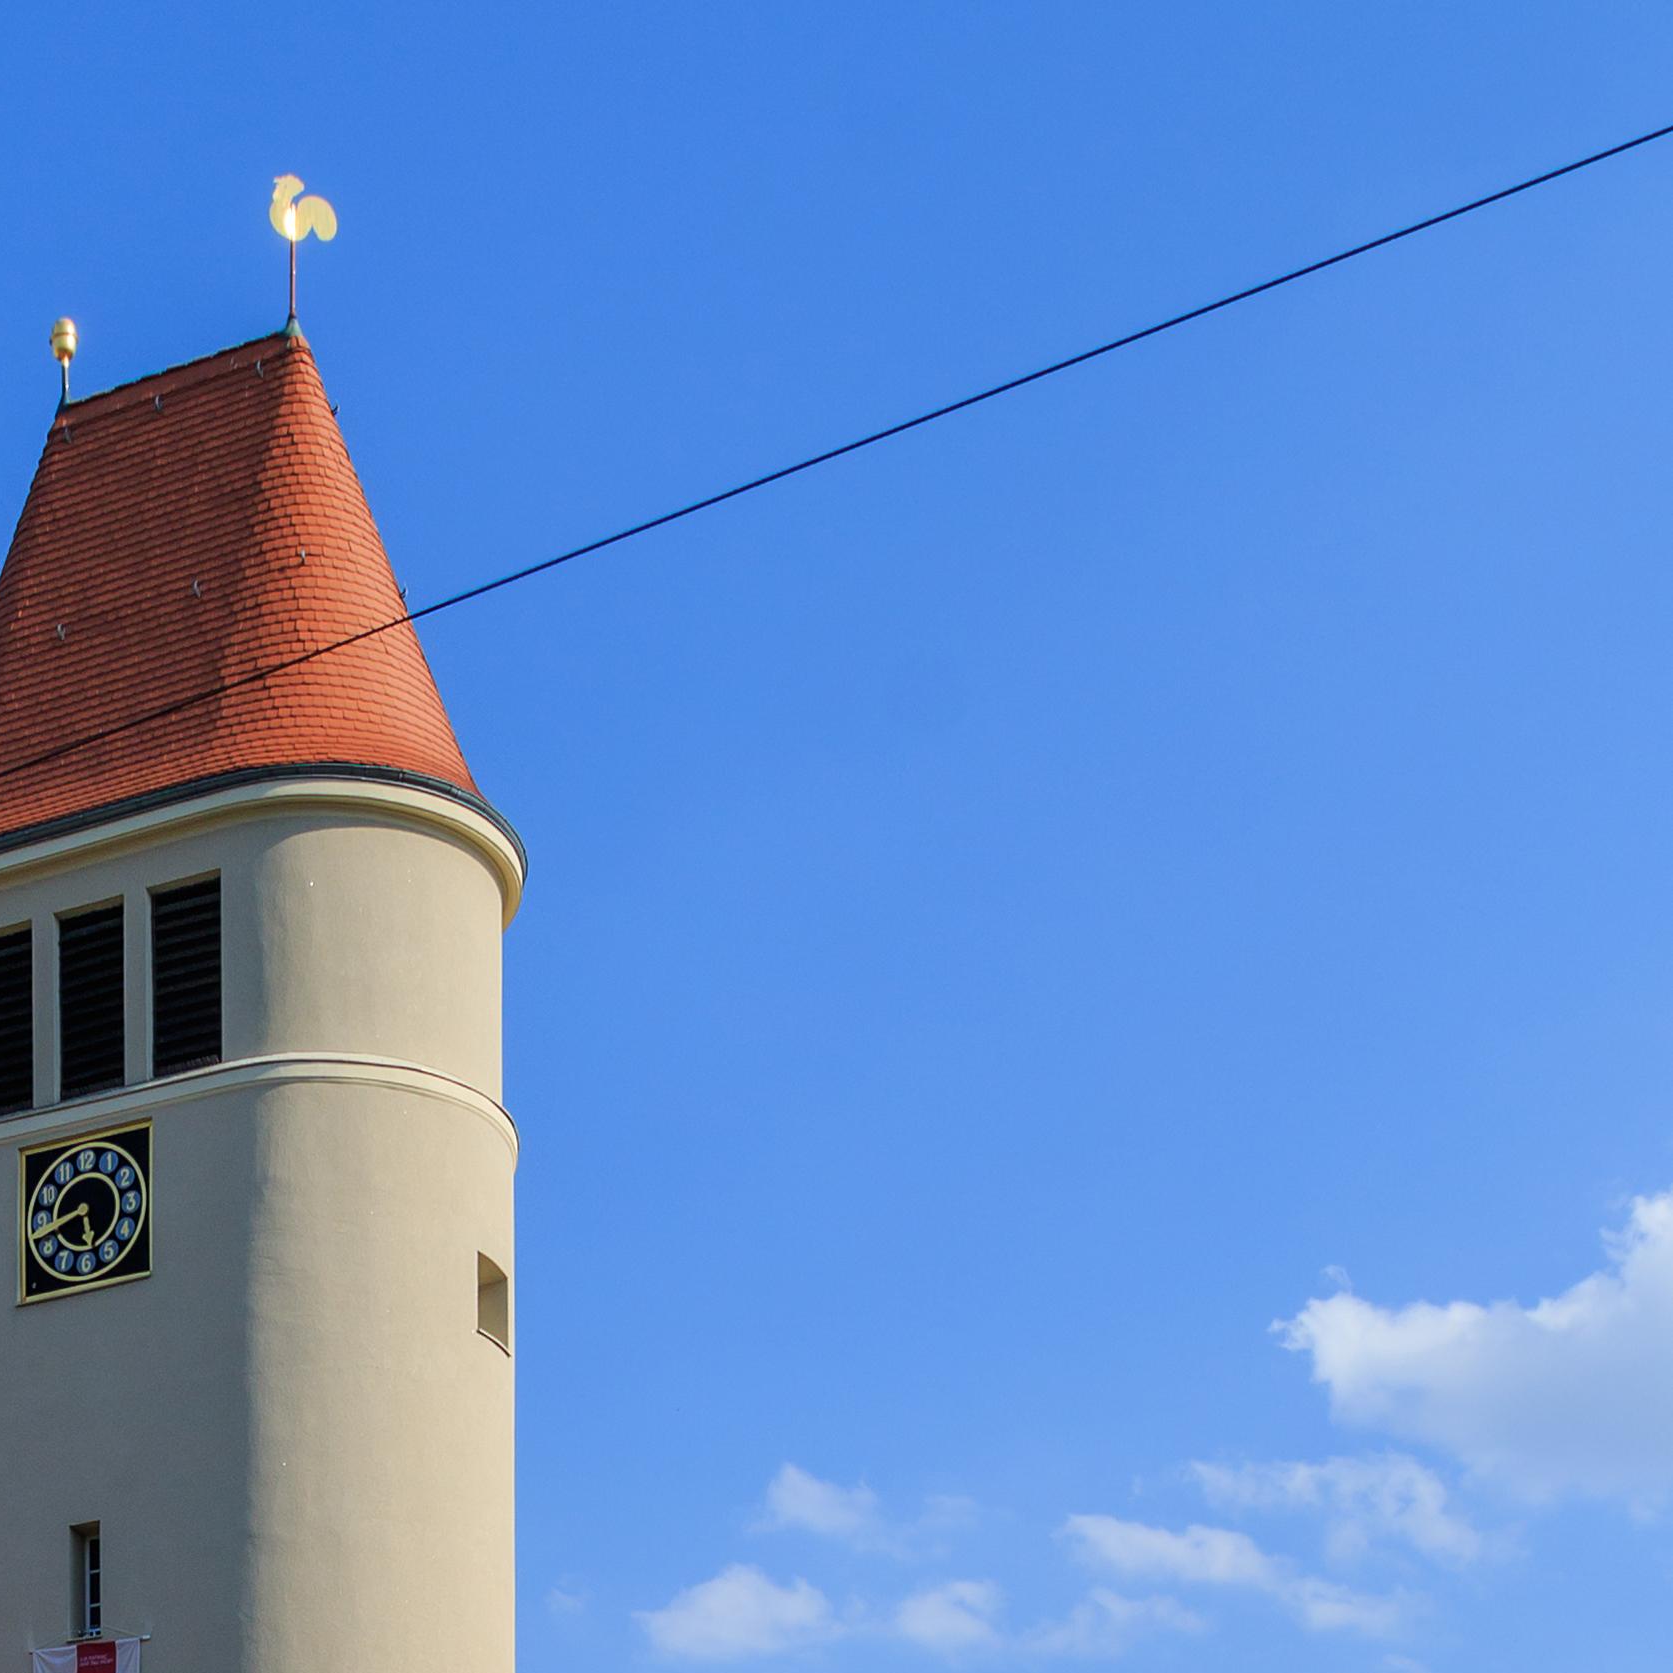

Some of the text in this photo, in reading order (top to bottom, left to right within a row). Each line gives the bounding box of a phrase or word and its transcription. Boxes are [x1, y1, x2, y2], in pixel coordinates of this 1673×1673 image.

[79, 1151, 93, 1171] 12
[106, 1152, 112, 1170] 1
[59, 1163, 71, 1183] 11
[120, 1169, 130, 1187] 2
[42, 1185, 55, 1205] 10
[126, 1193, 136, 1212] 3
[120, 1219, 129, 1239] 4
[43, 1238, 53, 1255] 8
[104, 1242, 114, 1260] 5
[60, 1252, 69, 1271] 7
[81, 1255, 91, 1273] 6
